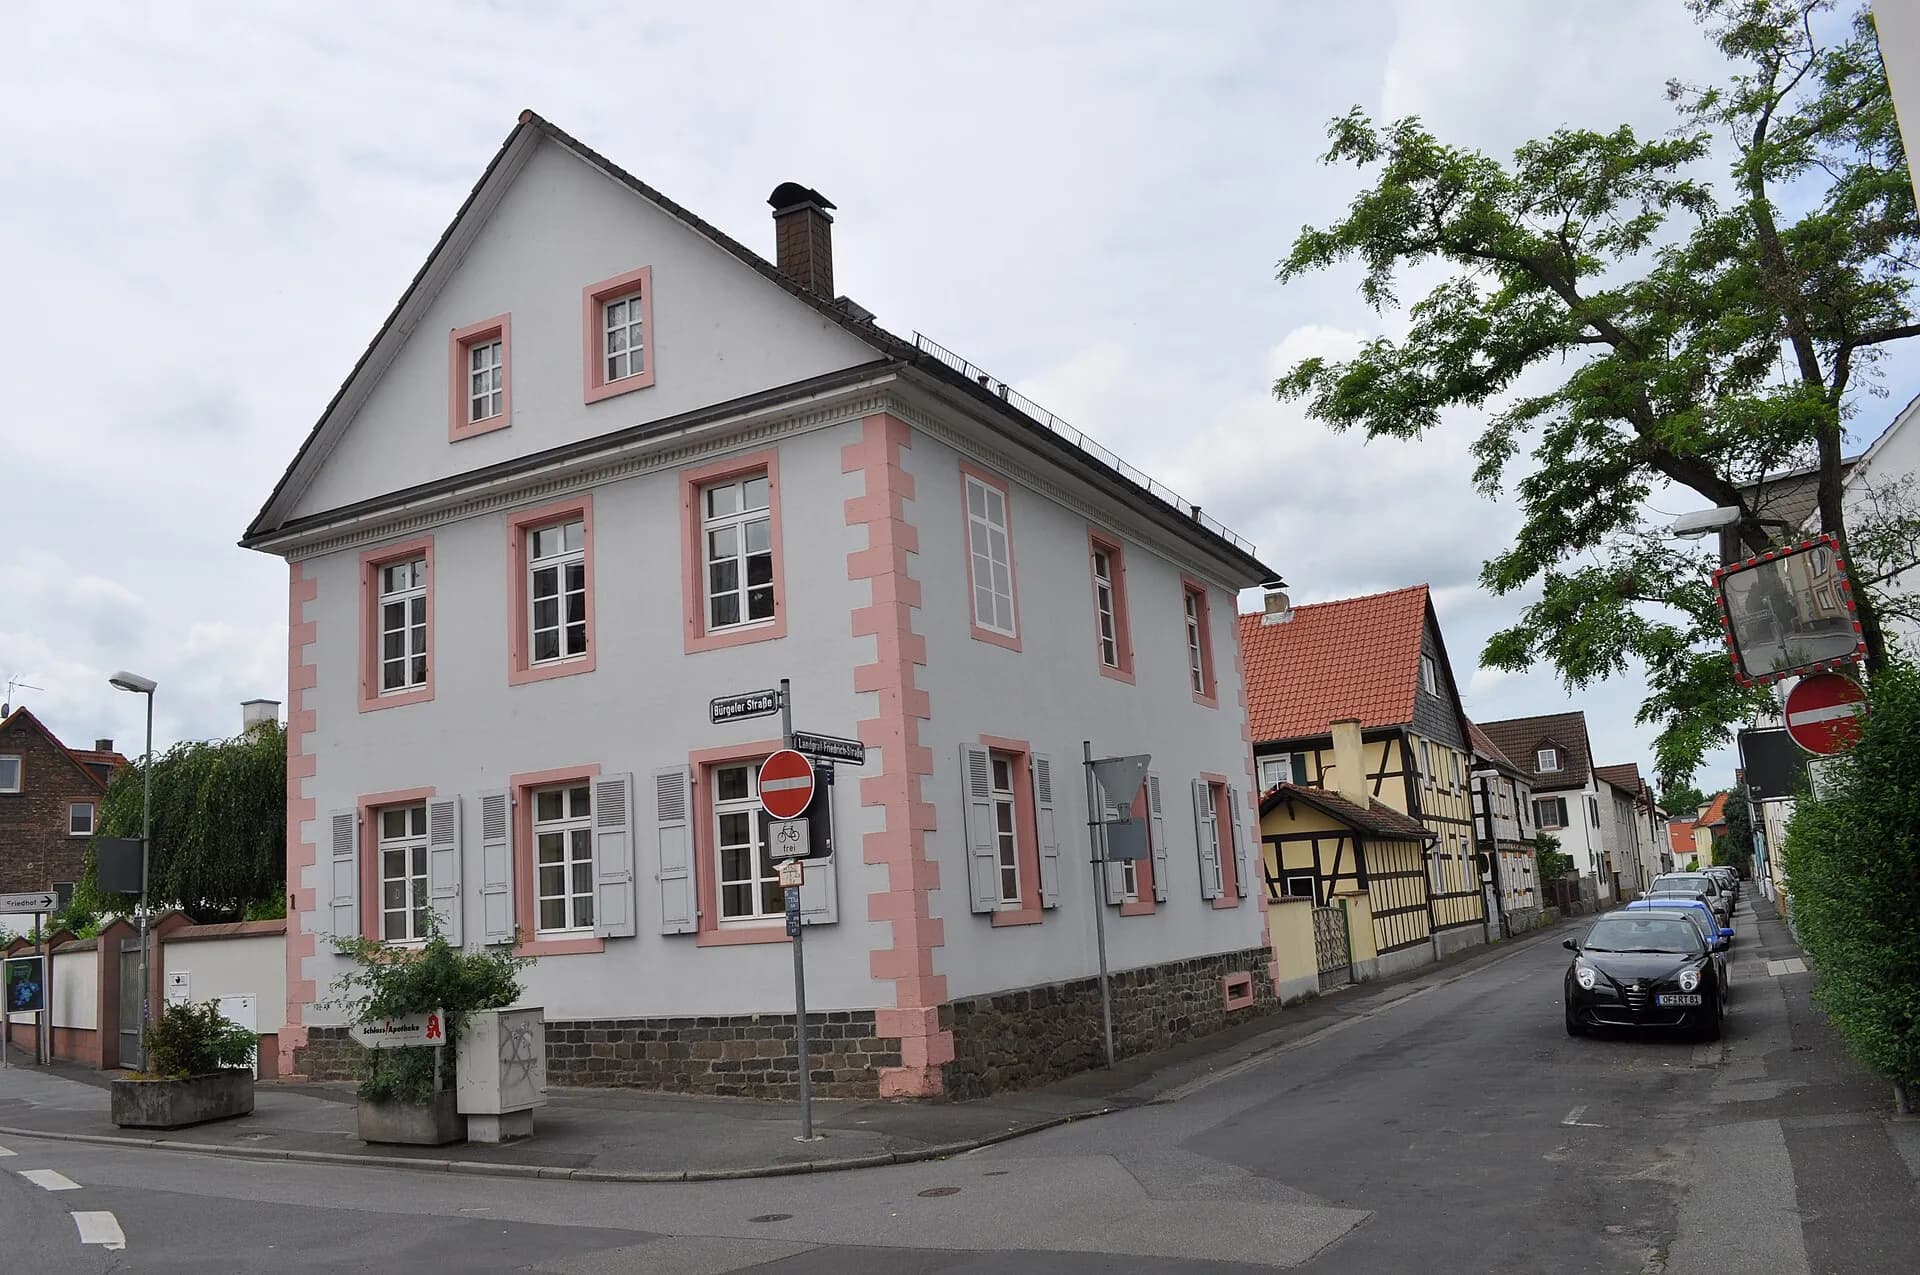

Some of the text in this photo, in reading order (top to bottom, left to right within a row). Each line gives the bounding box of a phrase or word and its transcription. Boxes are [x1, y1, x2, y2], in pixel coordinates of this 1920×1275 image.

[713, 697, 773, 717] Bürgeler Straße
[798, 738, 863, 758] Landgraf-Friedrich-Straße
[783, 844, 796, 853] frei
[6, 899, 37, 907] Friedhof
[1662, 995, 1673, 1003] OF
[1678, 995, 1688, 1004] RT
